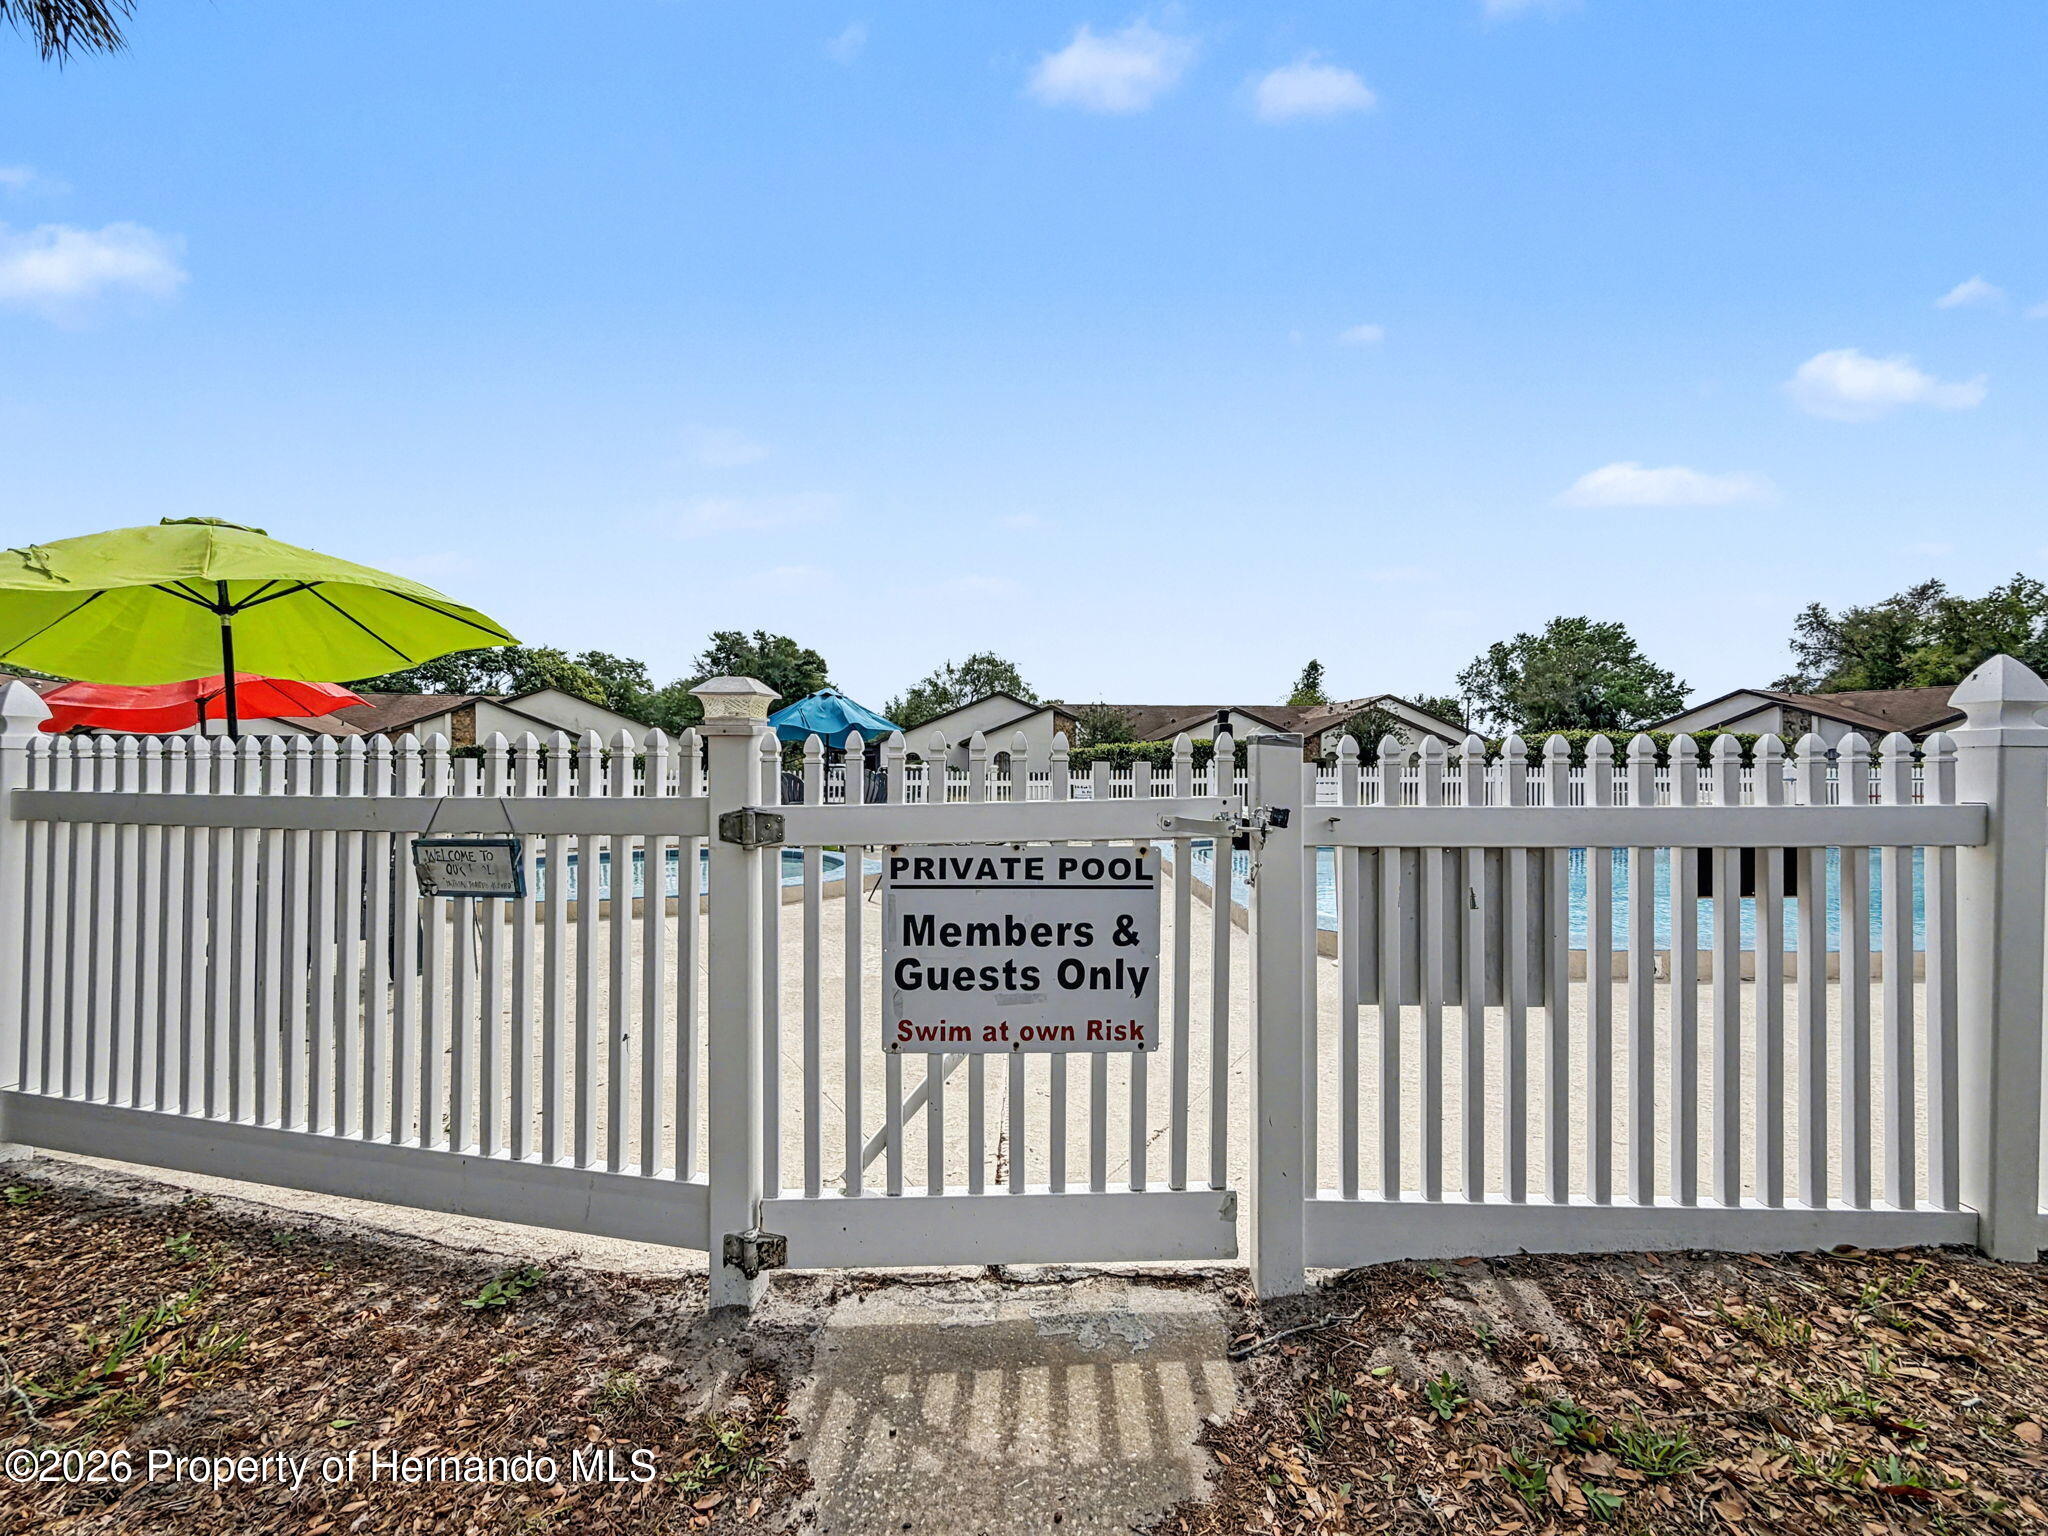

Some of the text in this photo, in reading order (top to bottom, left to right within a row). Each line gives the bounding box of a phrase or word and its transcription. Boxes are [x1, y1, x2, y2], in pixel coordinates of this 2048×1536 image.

[425, 848, 494, 863] WELCOME TO
[890, 857, 1154, 881] PRIVATE POOL
[902, 914, 1140, 947] Members &
[894, 957, 1150, 999] Guests Only
[897, 1019, 1145, 1042] Swim at own Risk
